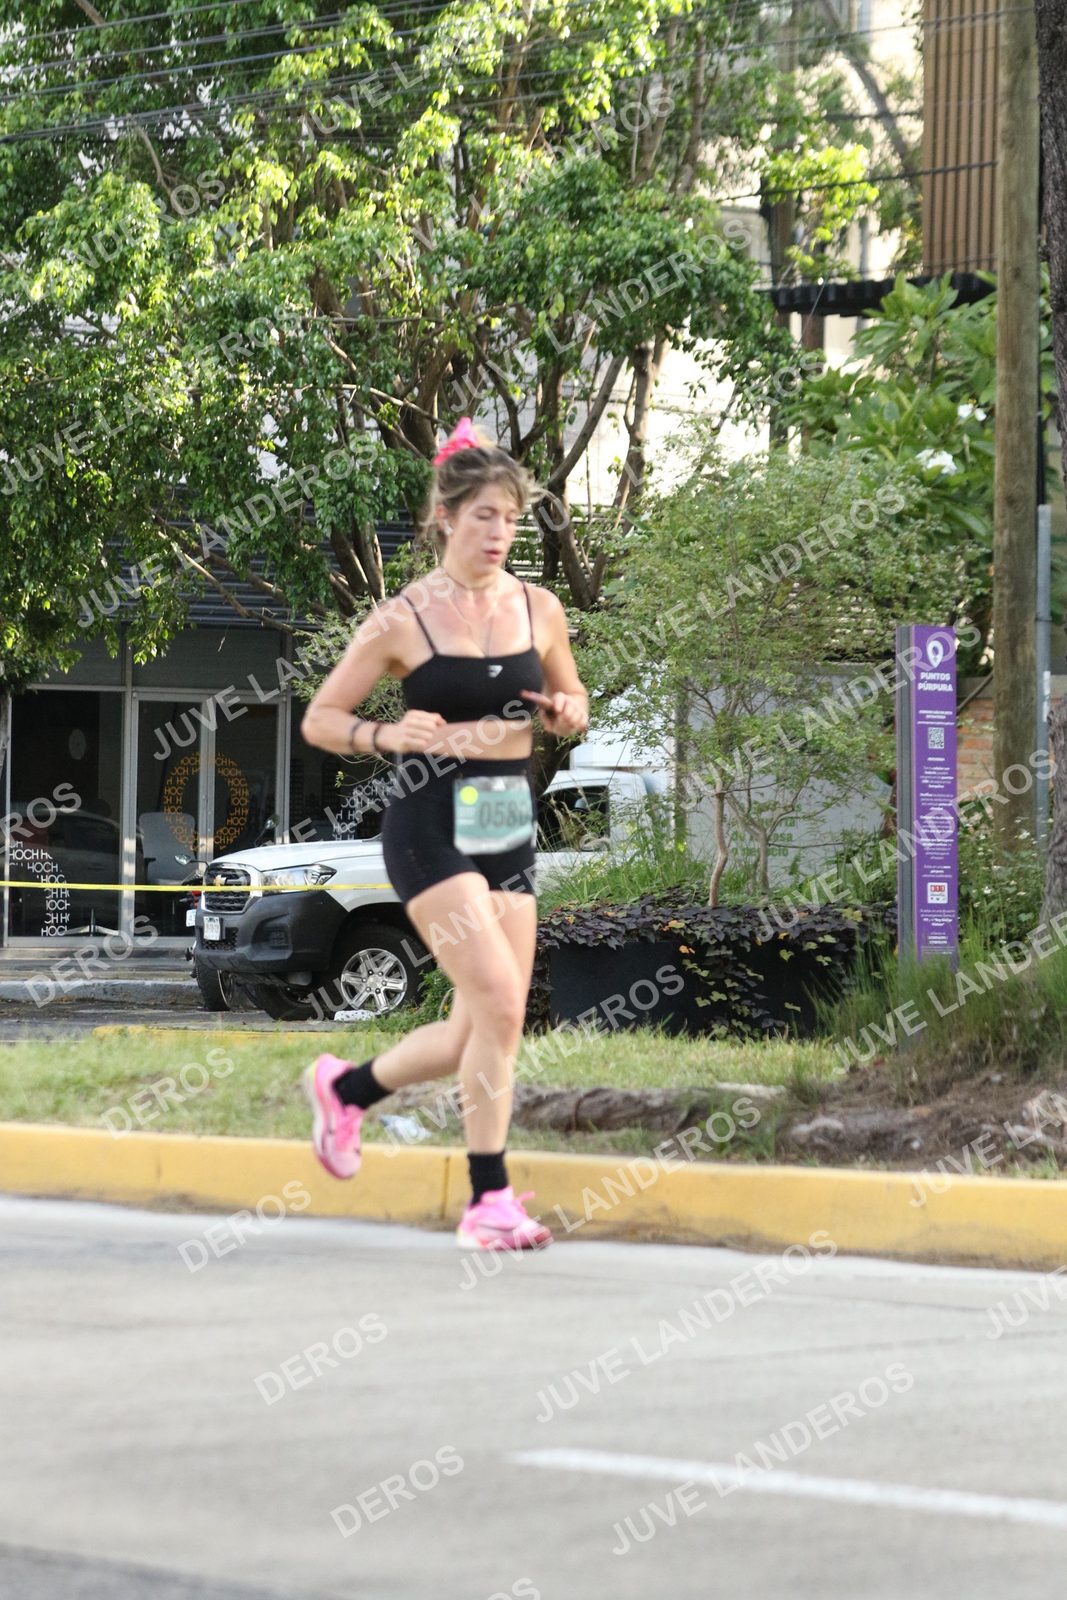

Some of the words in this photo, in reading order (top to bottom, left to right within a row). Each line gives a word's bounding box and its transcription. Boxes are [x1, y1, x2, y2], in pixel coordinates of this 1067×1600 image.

[920, 672, 951, 681] PUNTOS
[41, 875, 67, 884] HOC
[41, 926, 67, 937] HOC
